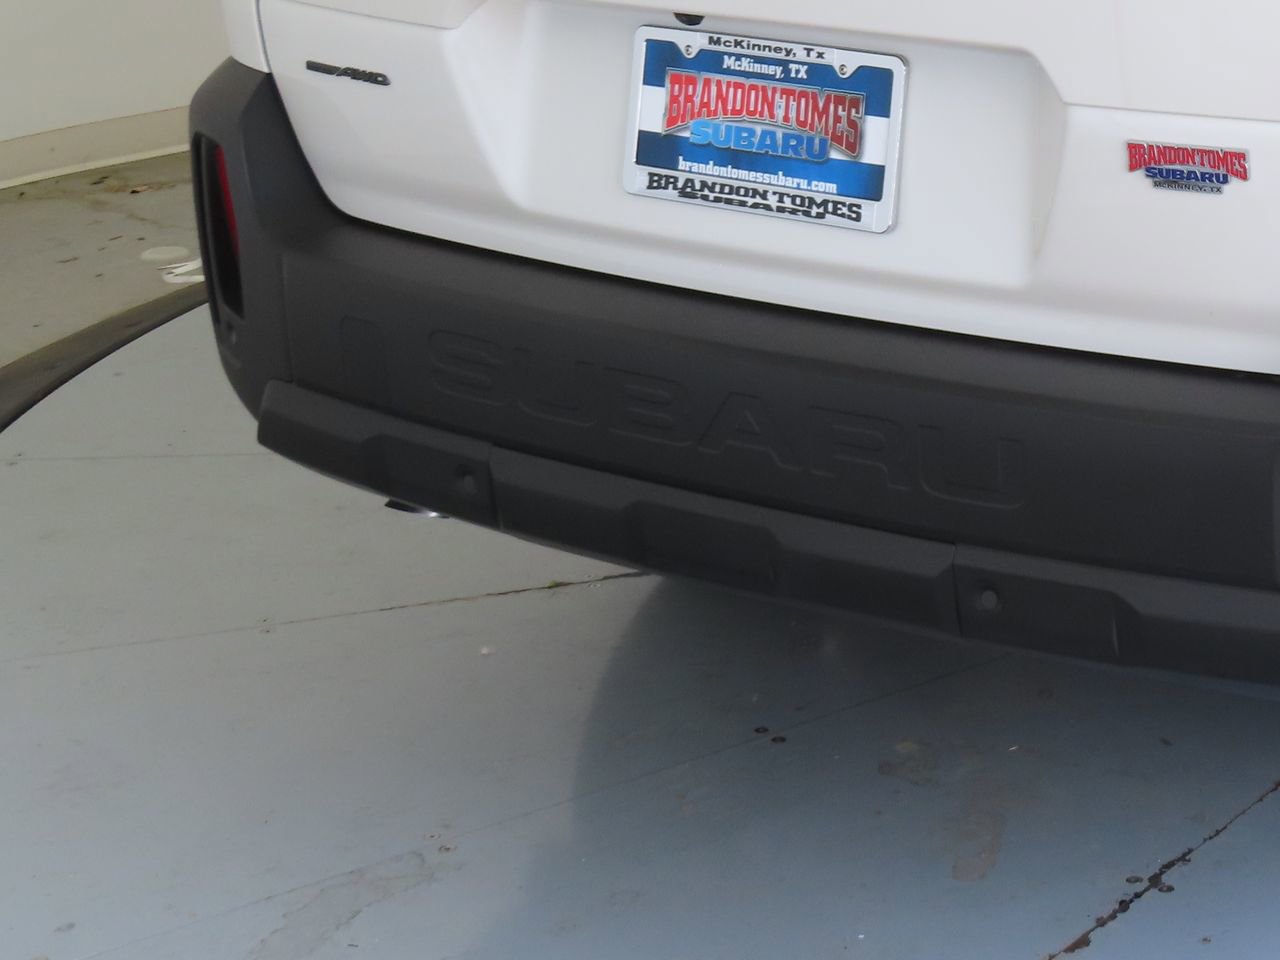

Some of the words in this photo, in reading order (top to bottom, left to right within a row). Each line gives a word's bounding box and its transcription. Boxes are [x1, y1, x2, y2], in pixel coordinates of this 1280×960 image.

[708, 35, 797, 58] McKinney,
[803, 47, 826, 60] Tx
[723, 55, 785, 79] McKinney,
[789, 64, 808, 79] TX
[665, 71, 776, 128] BRANDON
[776, 88, 862, 158] TOMES
[689, 119, 831, 161] SUBARU
[678, 156, 838, 194] brandontomessubaru.com
[1127, 142, 1197, 172] BRANDON
[1196, 148, 1248, 181] TOMES
[1145, 166, 1229, 185] SUBARU
[647, 172, 769, 201] BRANDON
[769, 190, 863, 223] TOMES
[678, 190, 827, 220] SUBARU
[429, 329, 1026, 510] SUBARU
